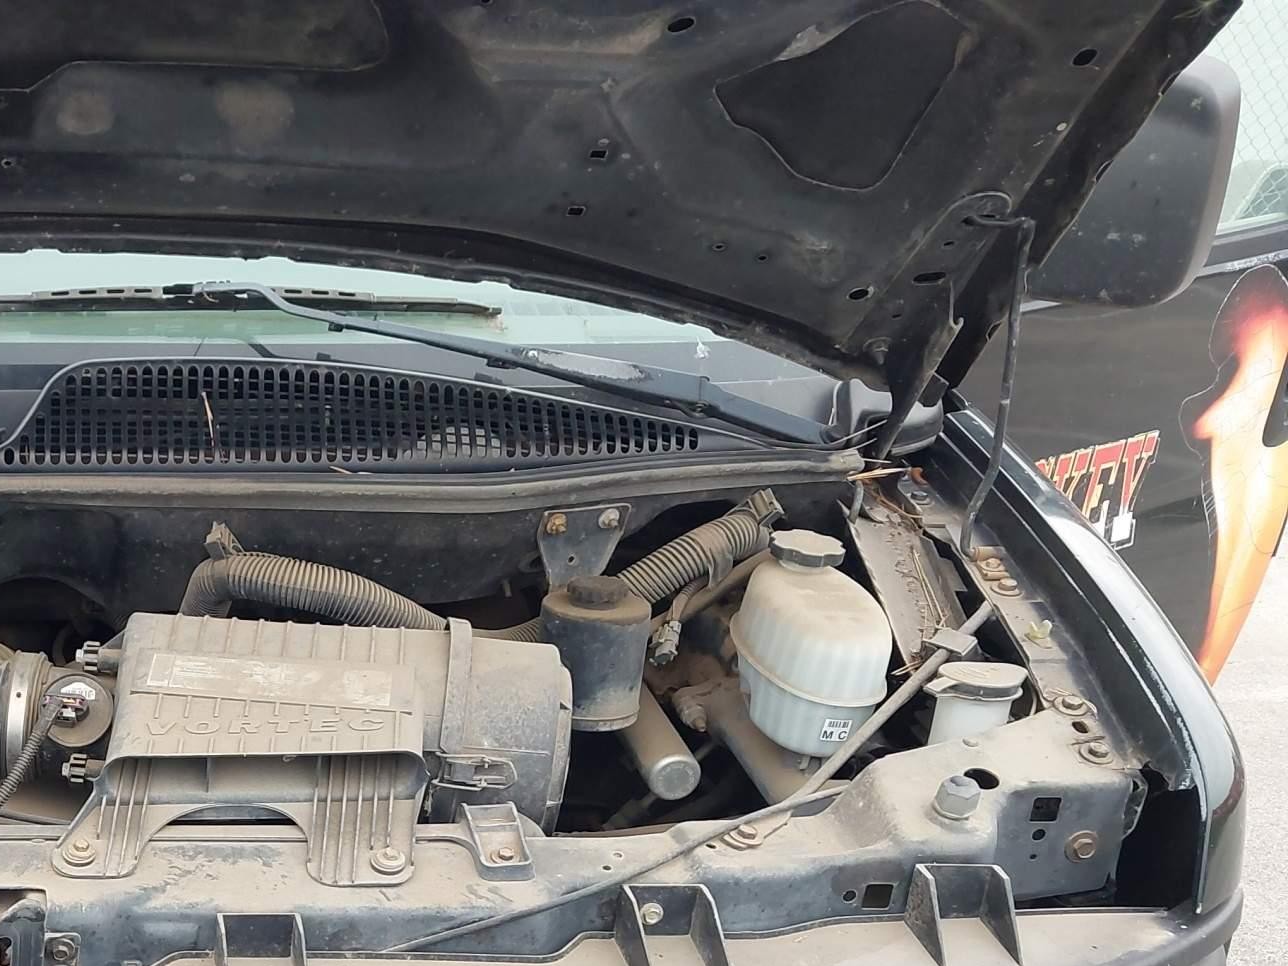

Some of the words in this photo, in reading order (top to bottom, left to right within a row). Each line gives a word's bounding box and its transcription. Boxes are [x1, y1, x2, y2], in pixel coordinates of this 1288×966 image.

[146, 719, 385, 736] VORTEC
[822, 730, 833, 740] M
[838, 730, 848, 740] C
